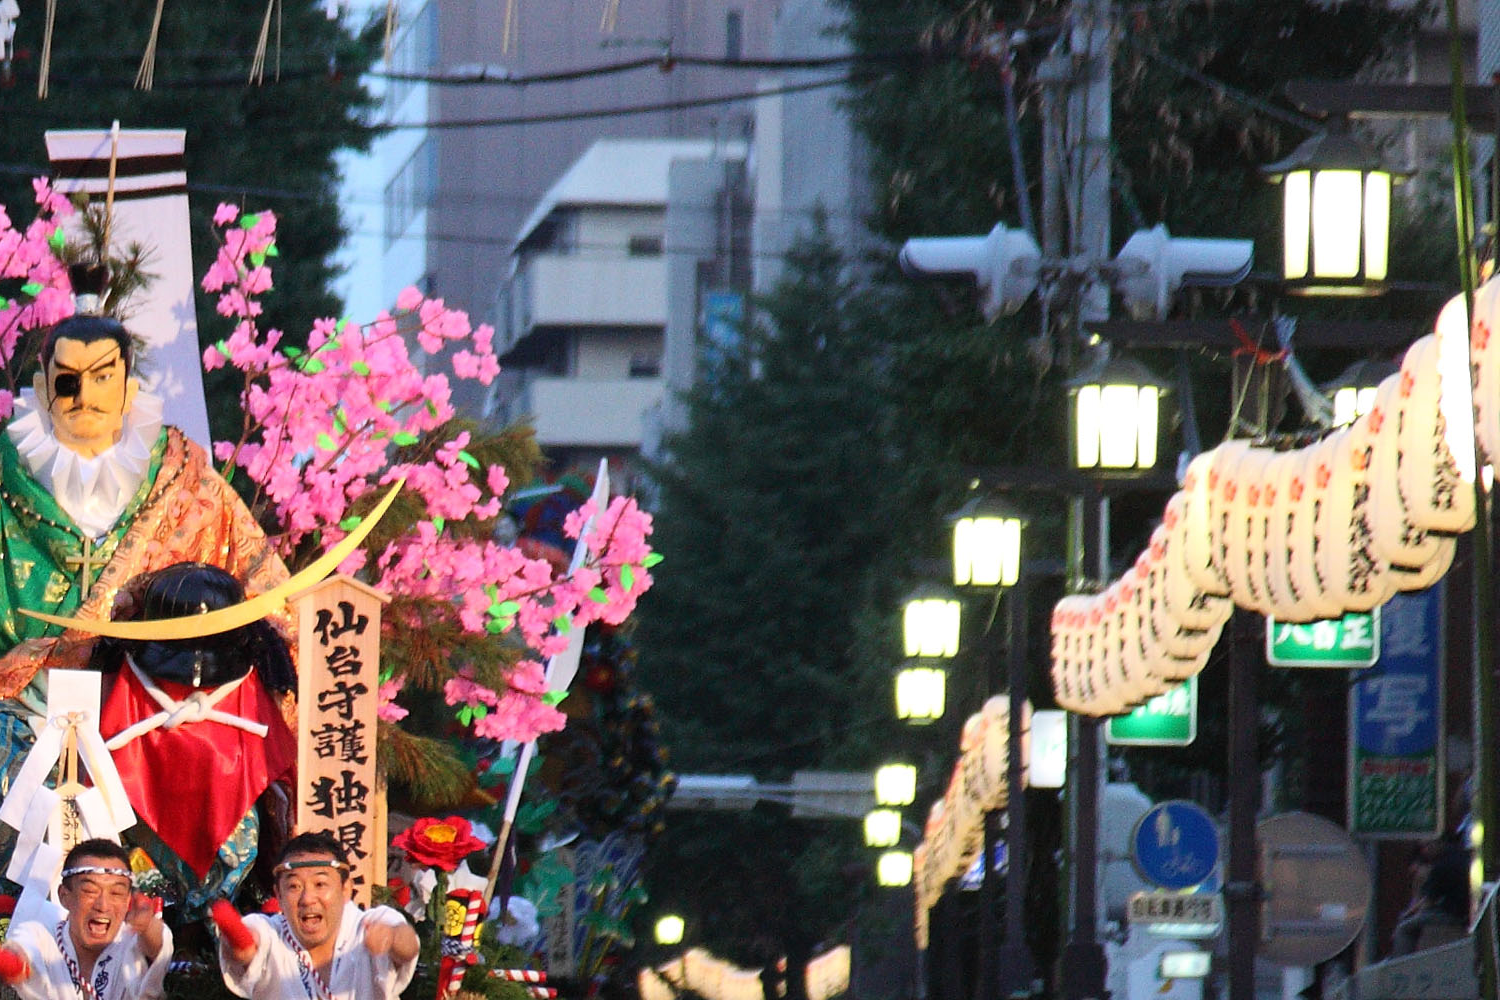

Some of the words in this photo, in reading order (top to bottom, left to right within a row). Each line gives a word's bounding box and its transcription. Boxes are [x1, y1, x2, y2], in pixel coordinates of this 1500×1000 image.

[305, 601, 370, 912] 仙台守護独眼
